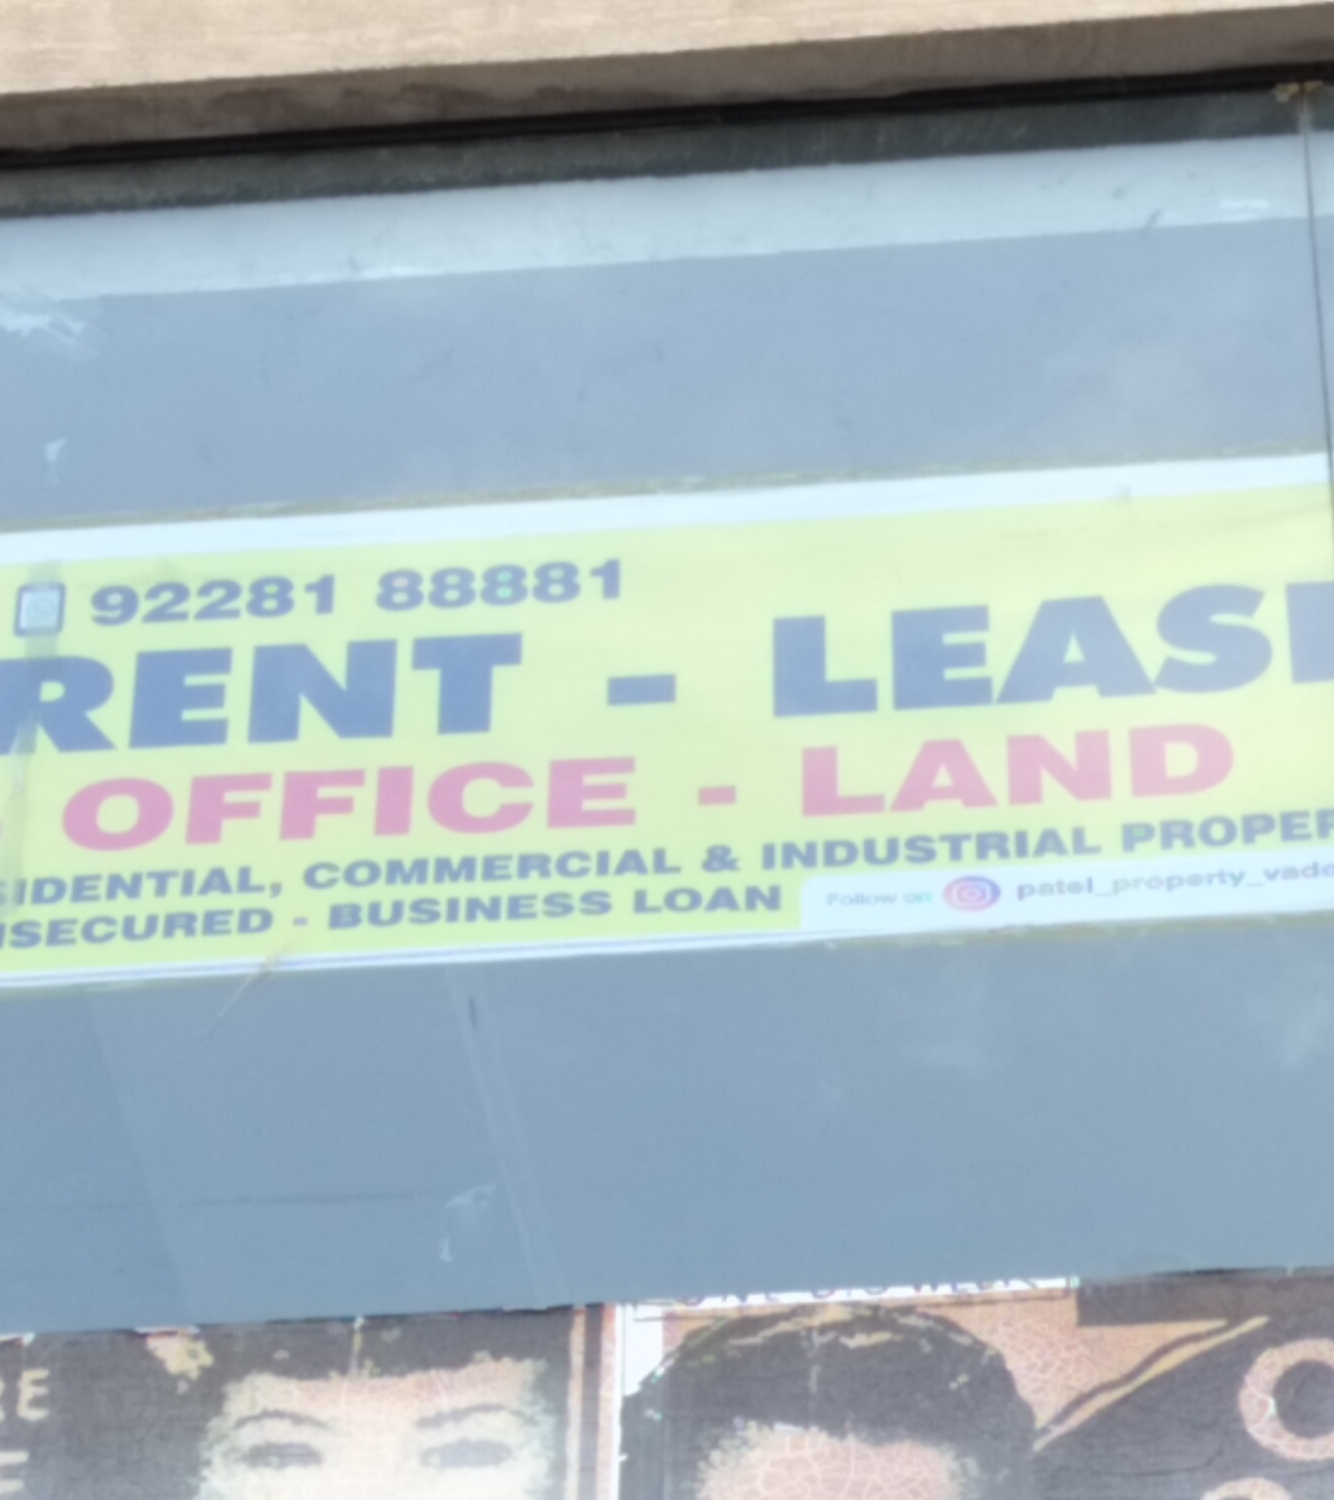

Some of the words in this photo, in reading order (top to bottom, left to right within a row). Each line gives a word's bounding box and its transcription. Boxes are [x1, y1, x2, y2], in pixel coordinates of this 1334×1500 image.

[91, 574, 336, 627] 92281
[376, 559, 622, 611] 88881
[61, 756, 636, 851] OFFICE
[801, 723, 1235, 817] LAND
[302, 847, 681, 890] COMMERCIAL
[700, 844, 741, 873] &
[761, 826, 1101, 872] INDUSTRIAL
[328, 890, 612, 930] BUSINESS
[632, 885, 782, 914] LOAN
